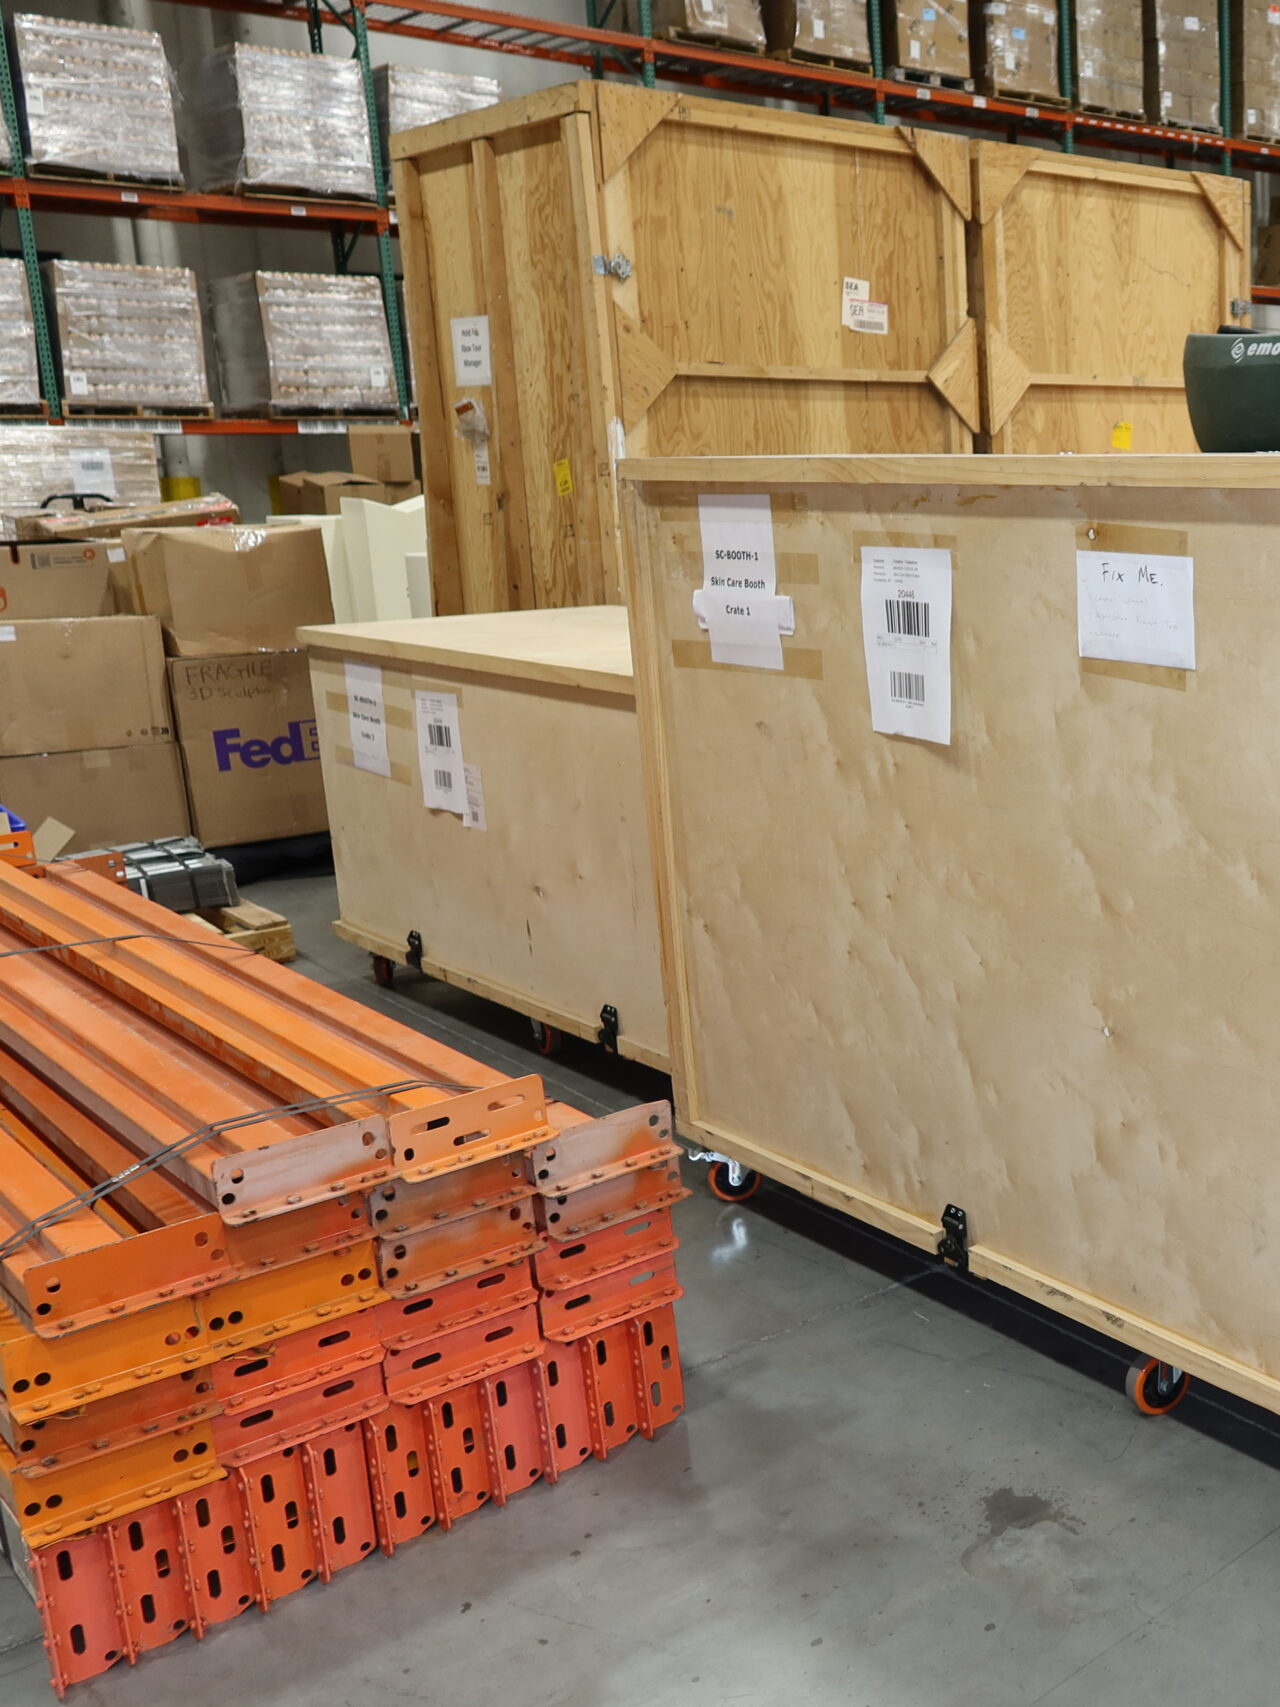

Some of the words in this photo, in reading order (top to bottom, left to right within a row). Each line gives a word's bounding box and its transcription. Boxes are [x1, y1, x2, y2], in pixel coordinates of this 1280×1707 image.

[845, 281, 858, 290] SEA
[715, 549, 759, 562] SC-BOOTH-1
[711, 576, 726, 587] Skin
[727, 577, 743, 588] Care
[744, 579, 766, 590] Booth
[725, 604, 745, 616] Crate
[746, 606, 751, 616] 1
[212, 720, 320, 772] FedE
